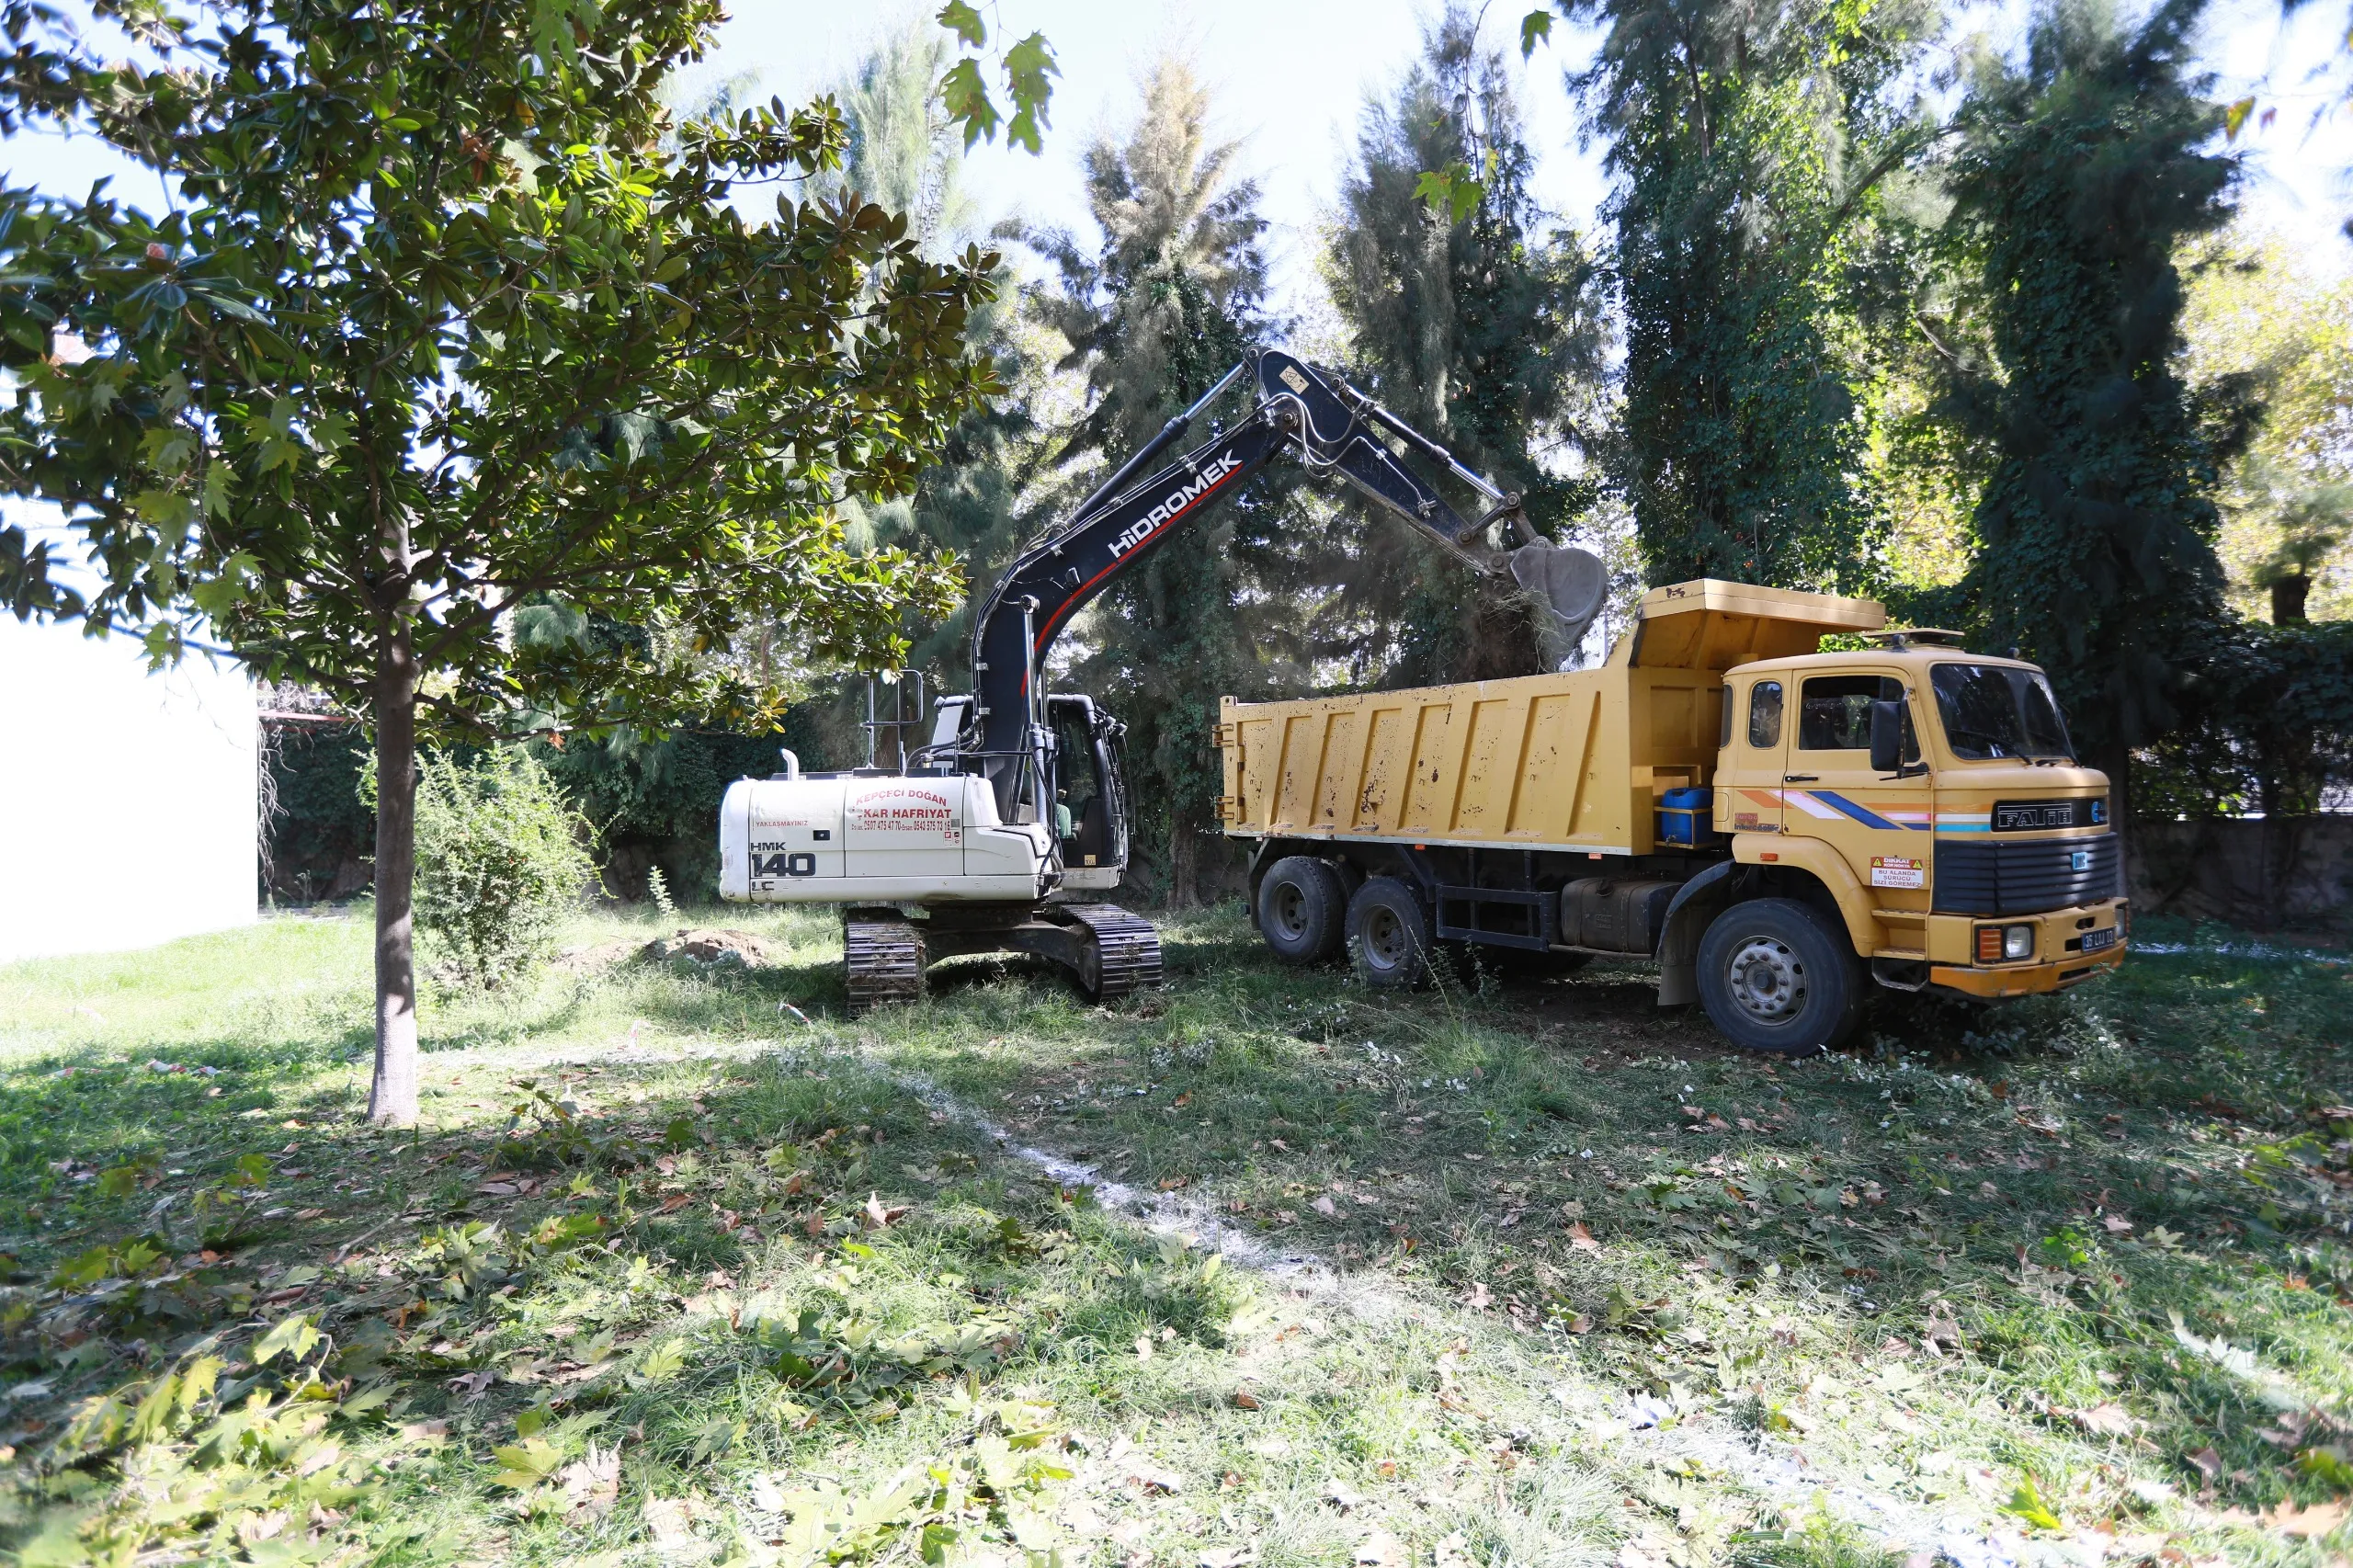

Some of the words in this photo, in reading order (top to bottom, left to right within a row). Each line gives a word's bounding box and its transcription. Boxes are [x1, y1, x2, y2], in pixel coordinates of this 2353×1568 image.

[908, 790, 947, 807] DOĞAN
[892, 807, 952, 818] HAFRİYAT
[750, 842, 787, 852] HMK
[751, 853, 816, 878] 140
[752, 881, 775, 891] LC
